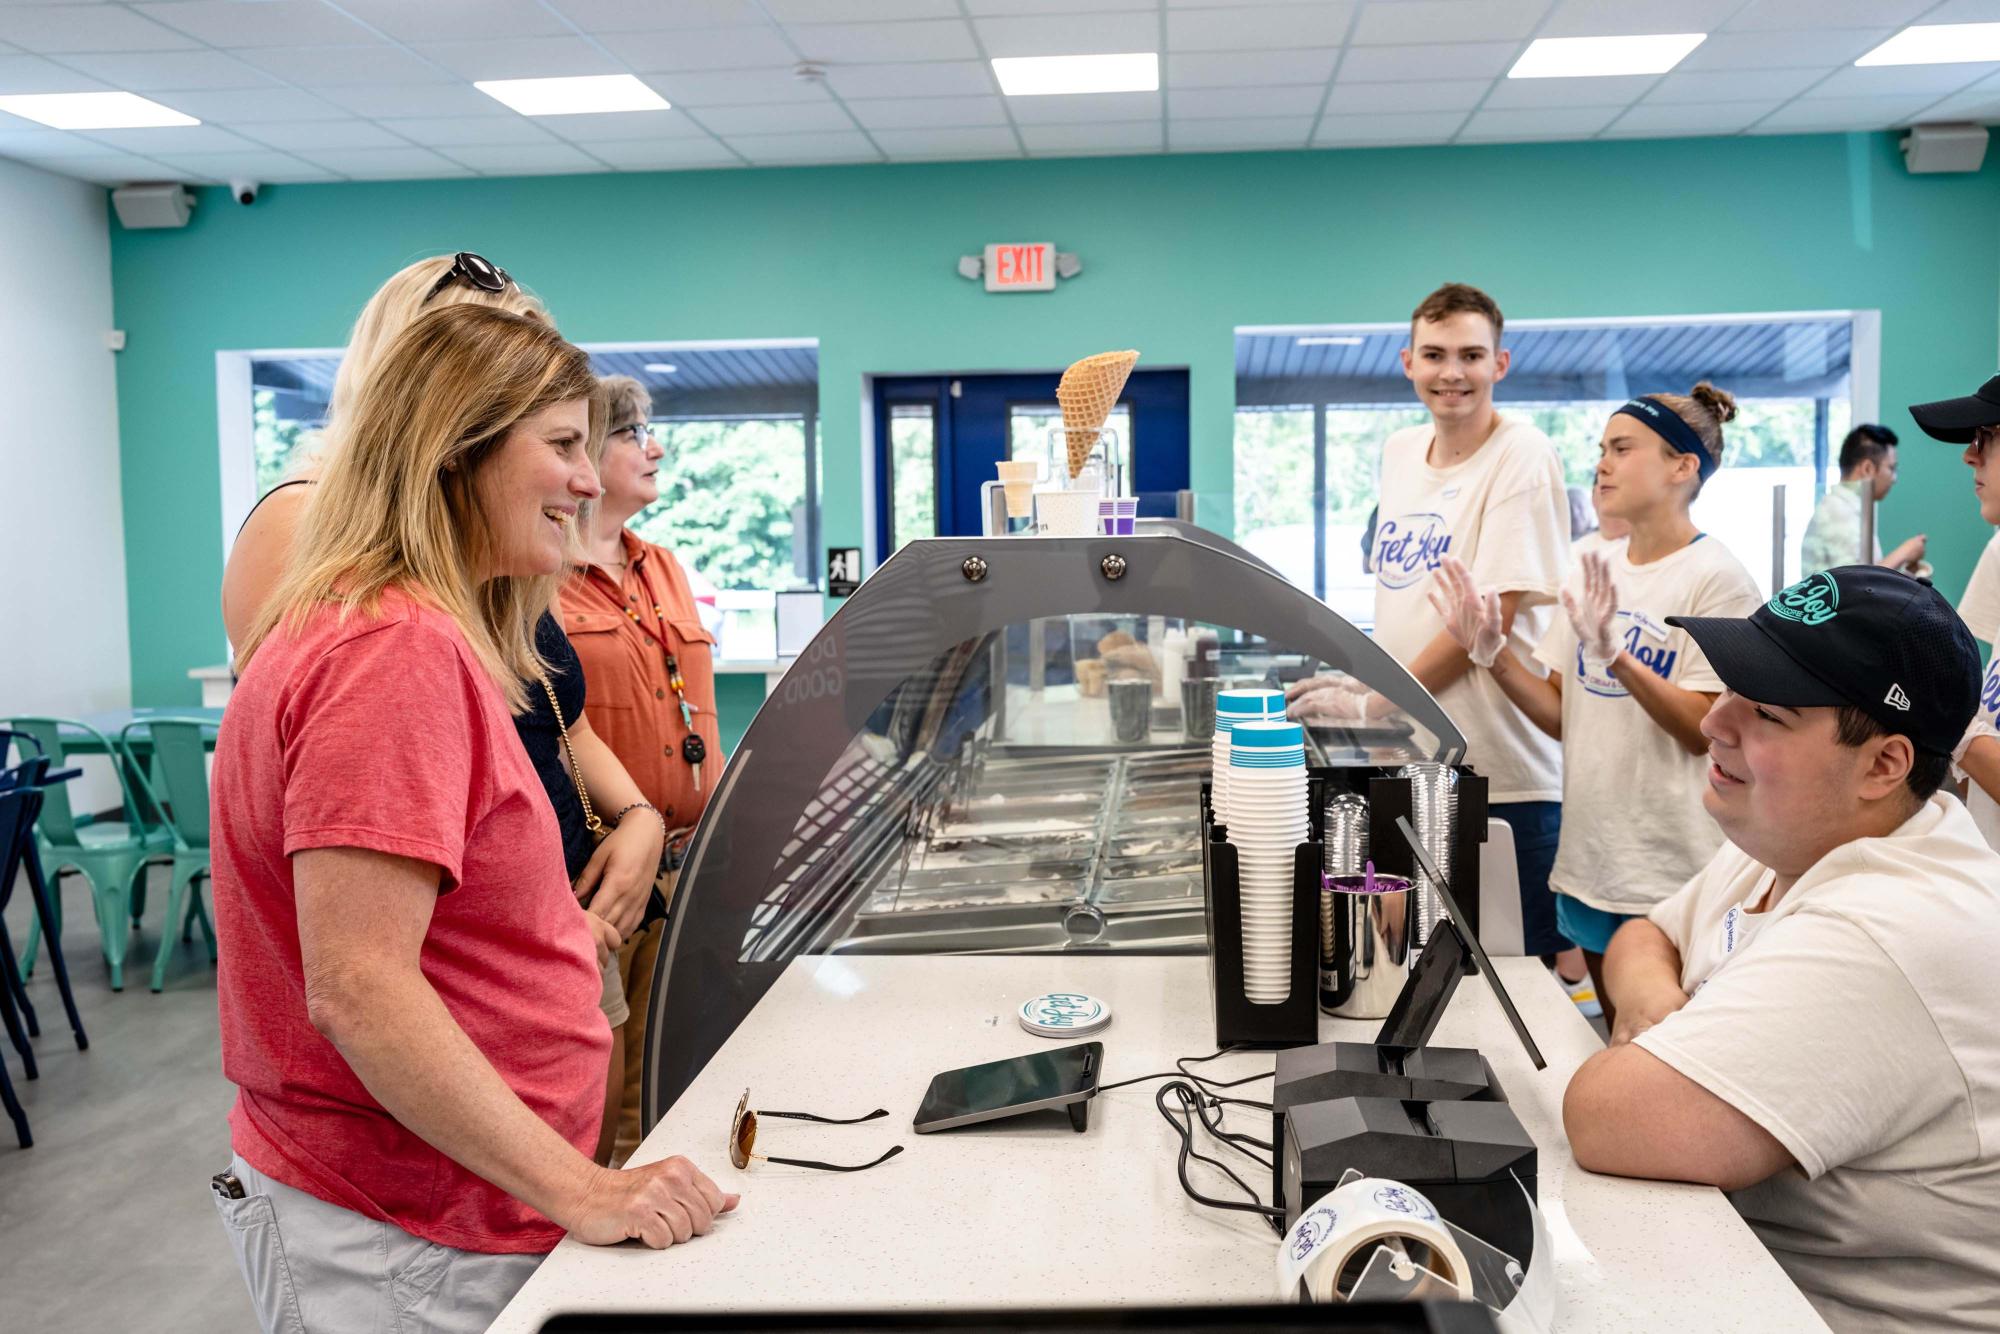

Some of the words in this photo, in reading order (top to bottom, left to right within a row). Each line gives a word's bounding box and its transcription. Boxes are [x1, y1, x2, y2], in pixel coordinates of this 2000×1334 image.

[997, 246, 1045, 283] EXIT
[1377, 521, 1413, 573] Get
[1403, 523, 1452, 572] Joy
[1784, 585, 1837, 625] Joy
[1039, 993, 1089, 1009] Get
